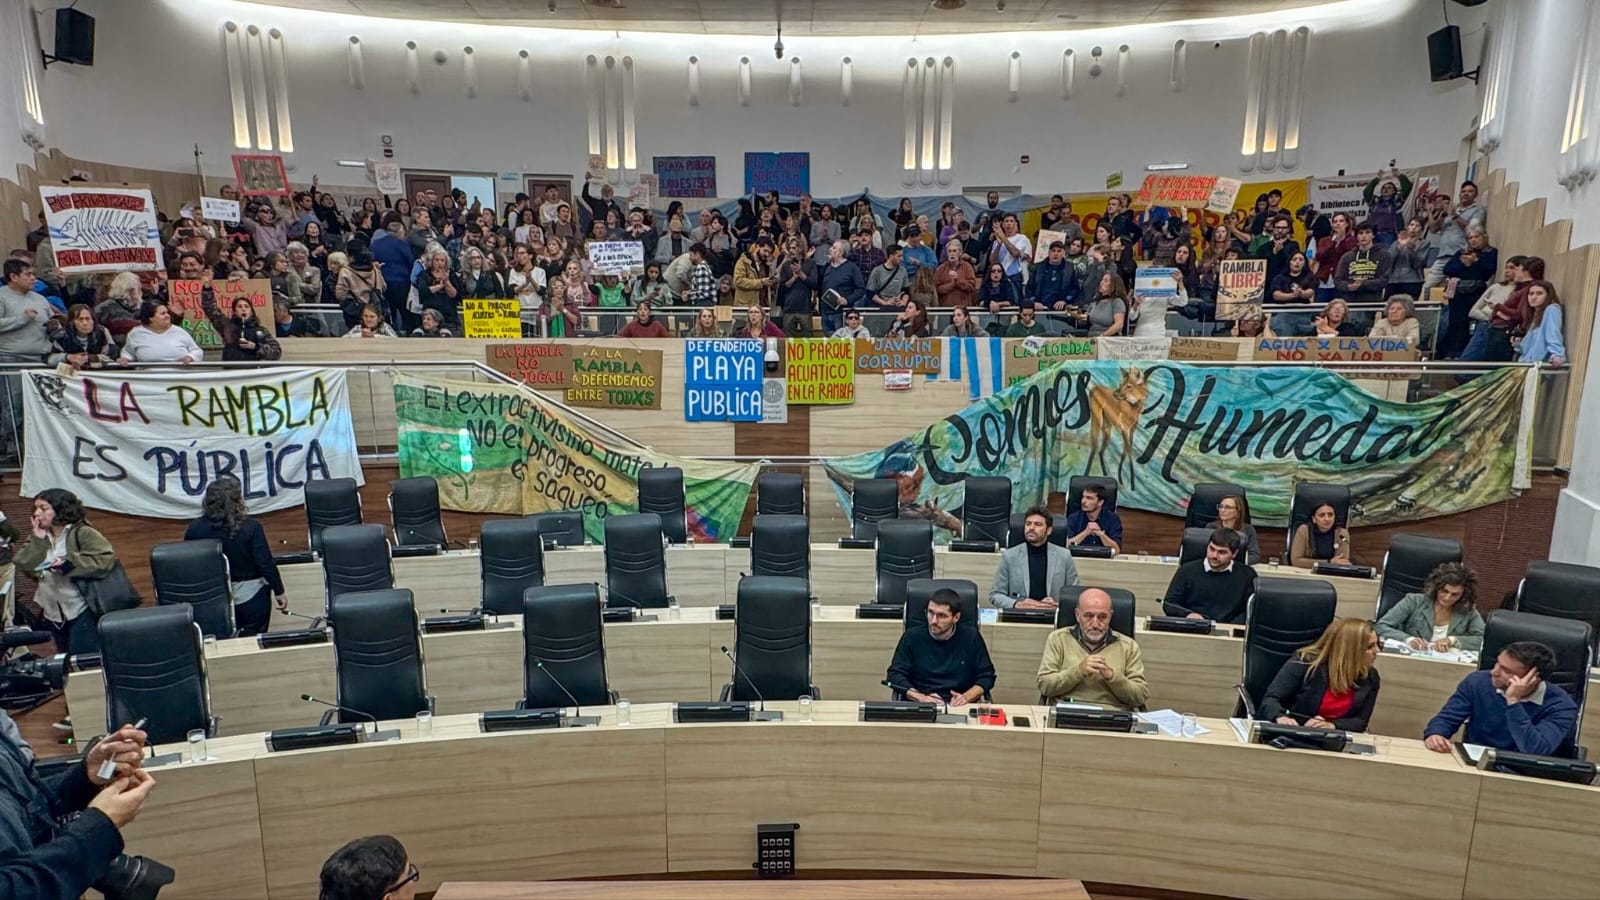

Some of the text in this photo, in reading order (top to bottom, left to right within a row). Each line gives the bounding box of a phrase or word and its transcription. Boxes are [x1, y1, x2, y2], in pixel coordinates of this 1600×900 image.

[1321, 200, 1360, 210] Biblioteca
[1222, 261, 1264, 273] RAMBLA
[174, 280, 201, 295] NO
[226, 281, 244, 293] LA
[1223, 273, 1263, 289] LIBRE
[495, 345, 564, 359] LA RAMBLA
[688, 341, 762, 353] DEFENDEMOS
[787, 342, 854, 361] NO PARQUE
[874, 338, 932, 353] JAVKIN
[1259, 338, 1308, 351] AGUA
[1339, 340, 1361, 350] LA
[606, 349, 623, 359] LA
[858, 354, 940, 369] CORRUPTO
[1276, 350, 1306, 361] NO
[1351, 351, 1384, 361] LOS
[517, 358, 540, 370] NO
[573, 358, 644, 374] RAMBLA
[693, 355, 756, 382] PLAYA
[581, 373, 655, 387] DEFENDEMOS
[567, 388, 655, 406] ENTRE TODXS
[787, 382, 855, 401] EN LA RAMBLA
[82, 375, 330, 438] LA RAMBLA
[424, 384, 452, 412] El
[456, 390, 594, 457] extractivismo
[1136, 364, 1462, 486] Humedal
[466, 419, 497, 448] NO
[72, 436, 128, 482] ES
